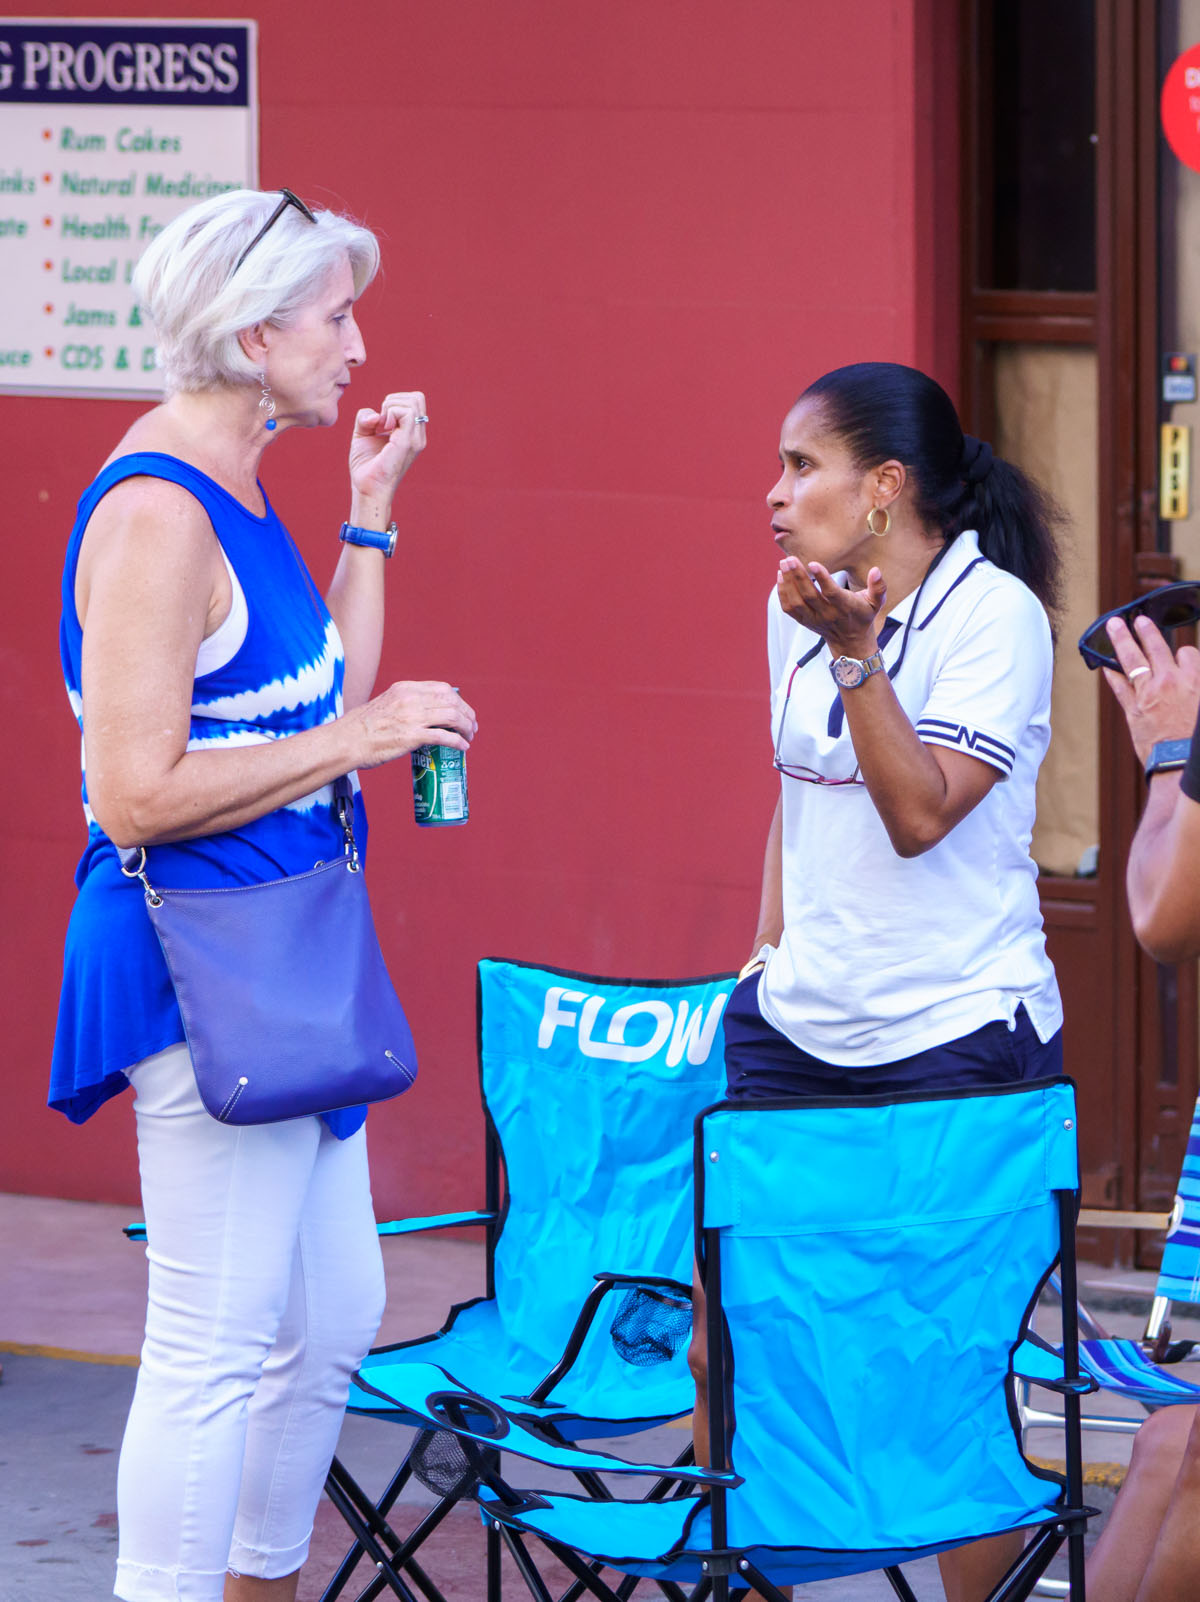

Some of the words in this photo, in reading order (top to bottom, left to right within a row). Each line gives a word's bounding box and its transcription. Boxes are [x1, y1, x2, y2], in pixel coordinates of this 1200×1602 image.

[22, 42, 239, 93] PROGRESS
[61, 127, 106, 151] Rum
[116, 127, 181, 152] Cakes
[61, 172, 135, 196] Natural
[61, 214, 130, 239] Health
[62, 258, 117, 283] Local
[64, 302, 117, 327] Jams
[537, 987, 728, 1068] FLOW
